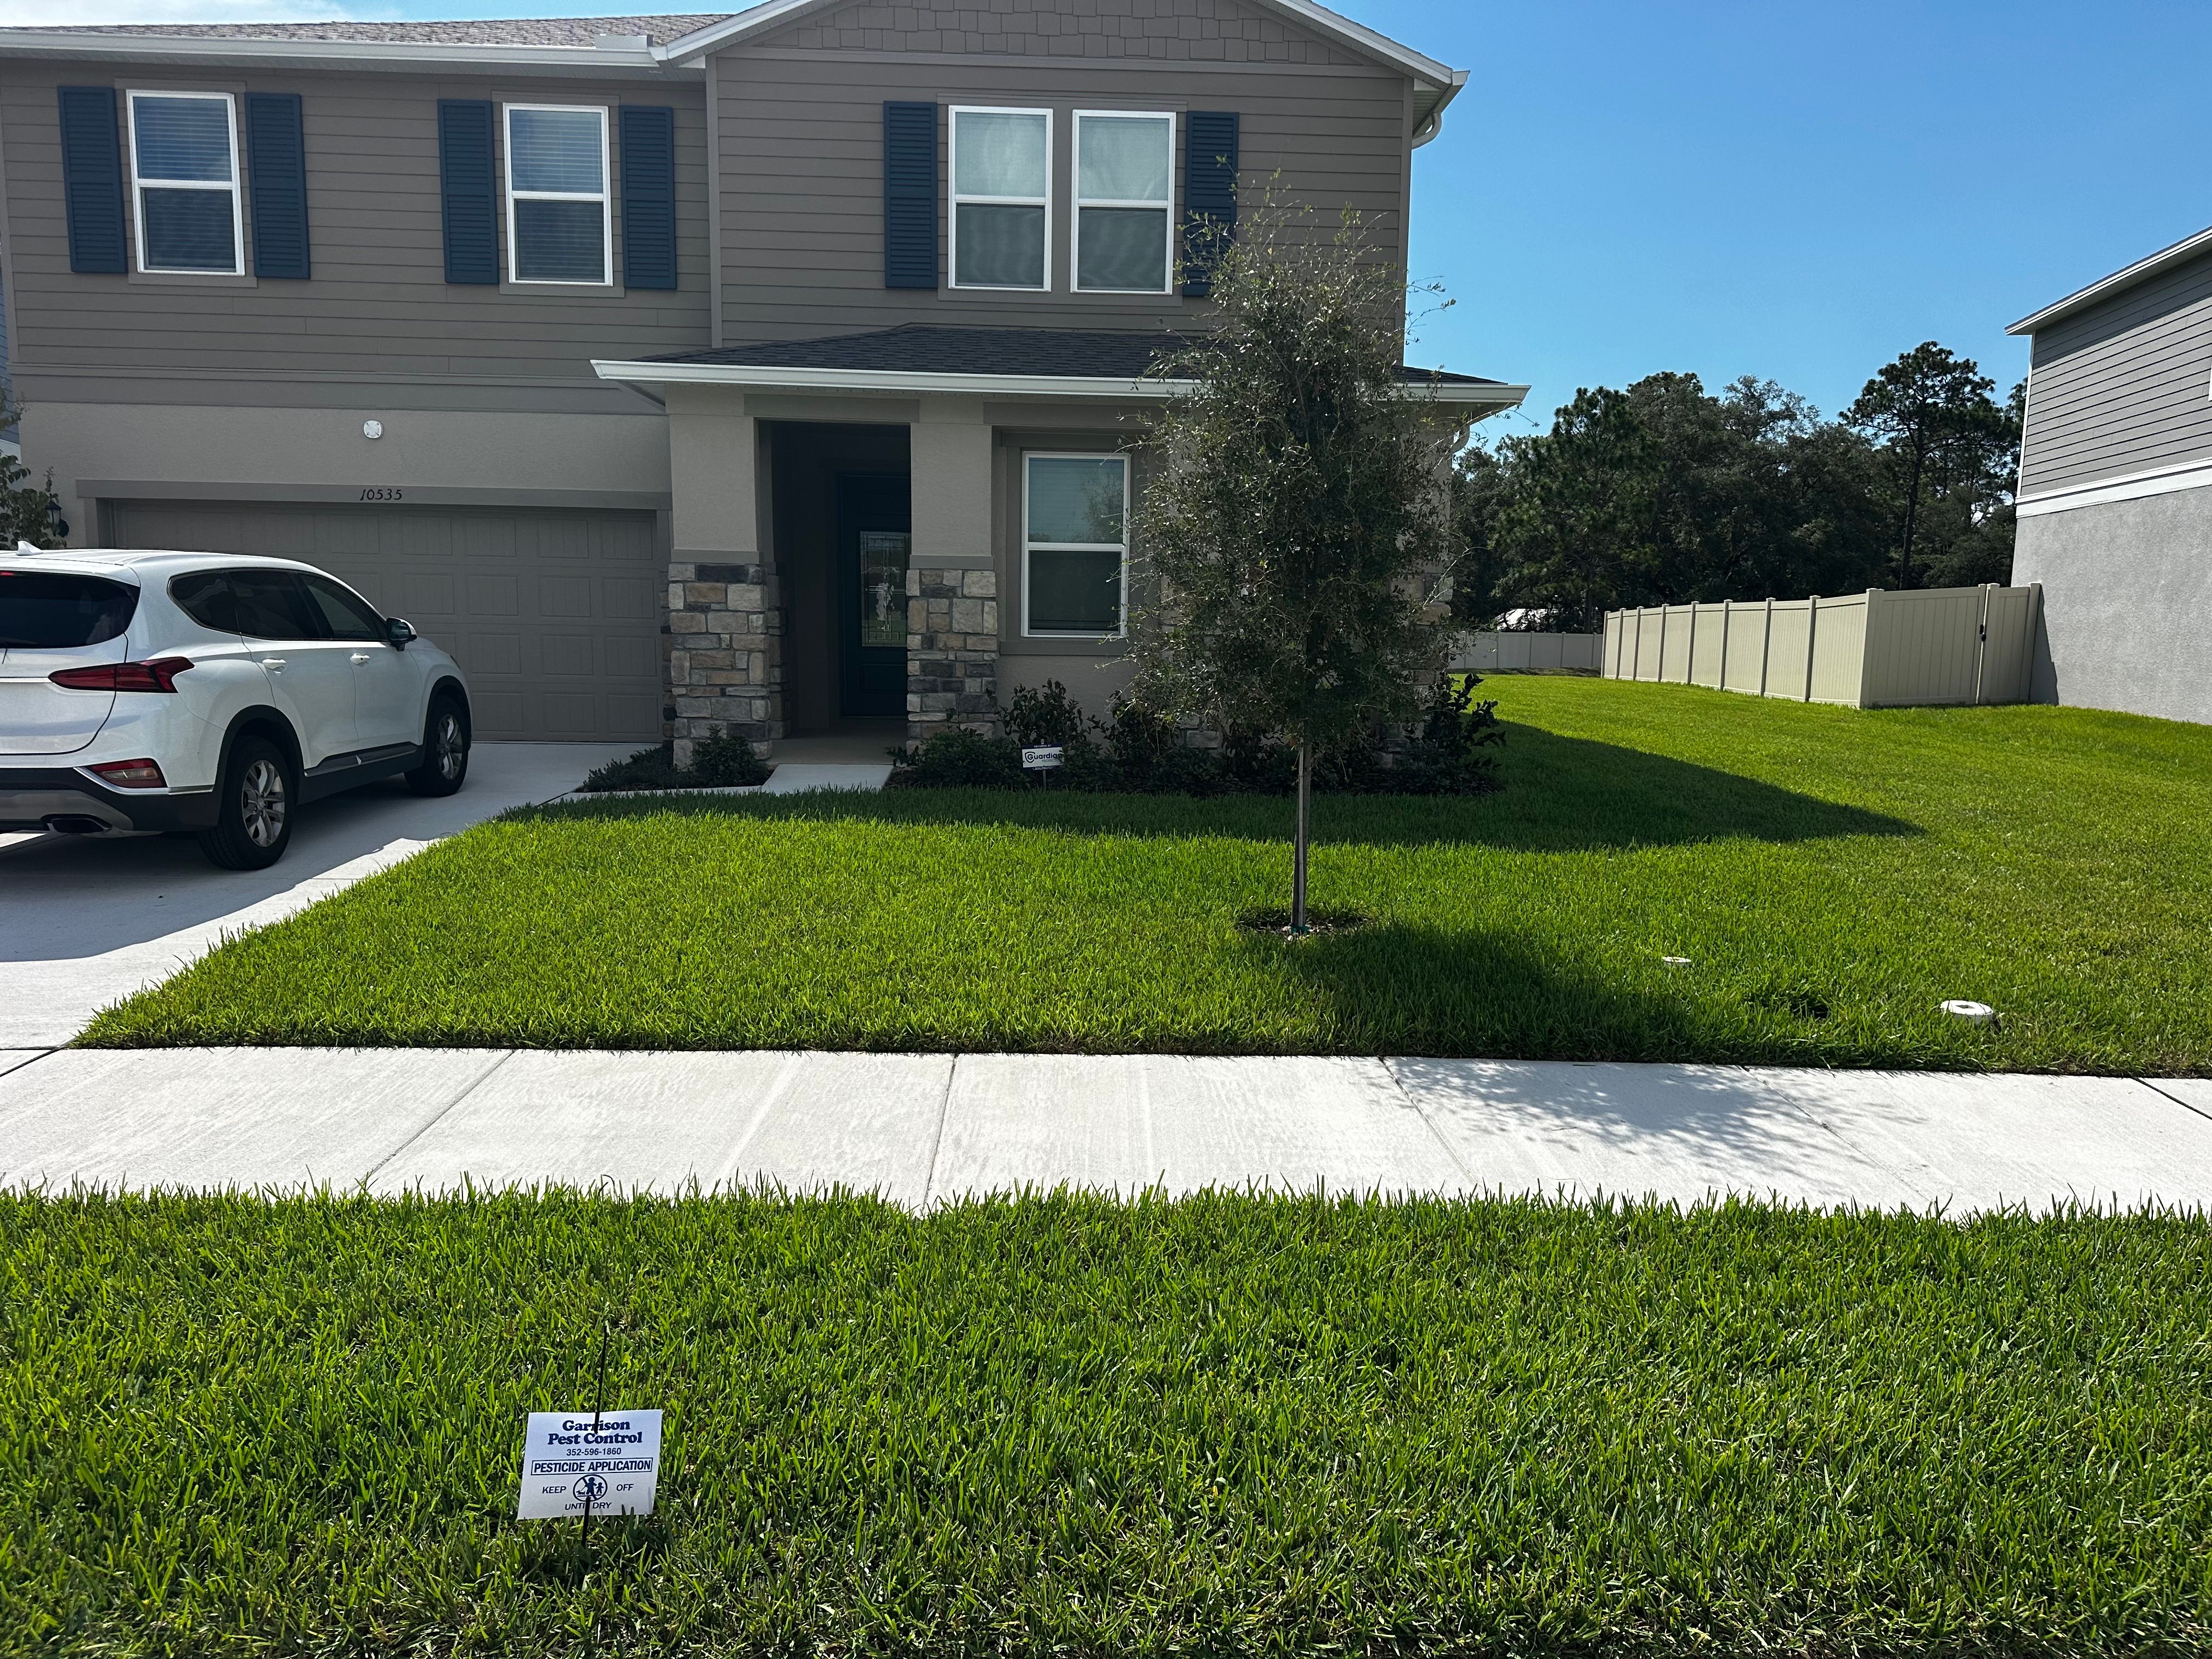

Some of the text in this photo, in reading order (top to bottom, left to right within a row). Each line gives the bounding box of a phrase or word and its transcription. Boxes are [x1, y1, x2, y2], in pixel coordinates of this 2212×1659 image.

[360, 489, 402, 501] 10535
[1026, 752, 1063, 761] Guardia
[548, 1431, 642, 1445] Pest Control
[566, 1447, 622, 1456] 352-596-1860
[534, 1460, 651, 1473] PESTICIDE APPLICATION
[542, 1486, 567, 1494] KEEP
[565, 1502, 590, 1510] UNTI
